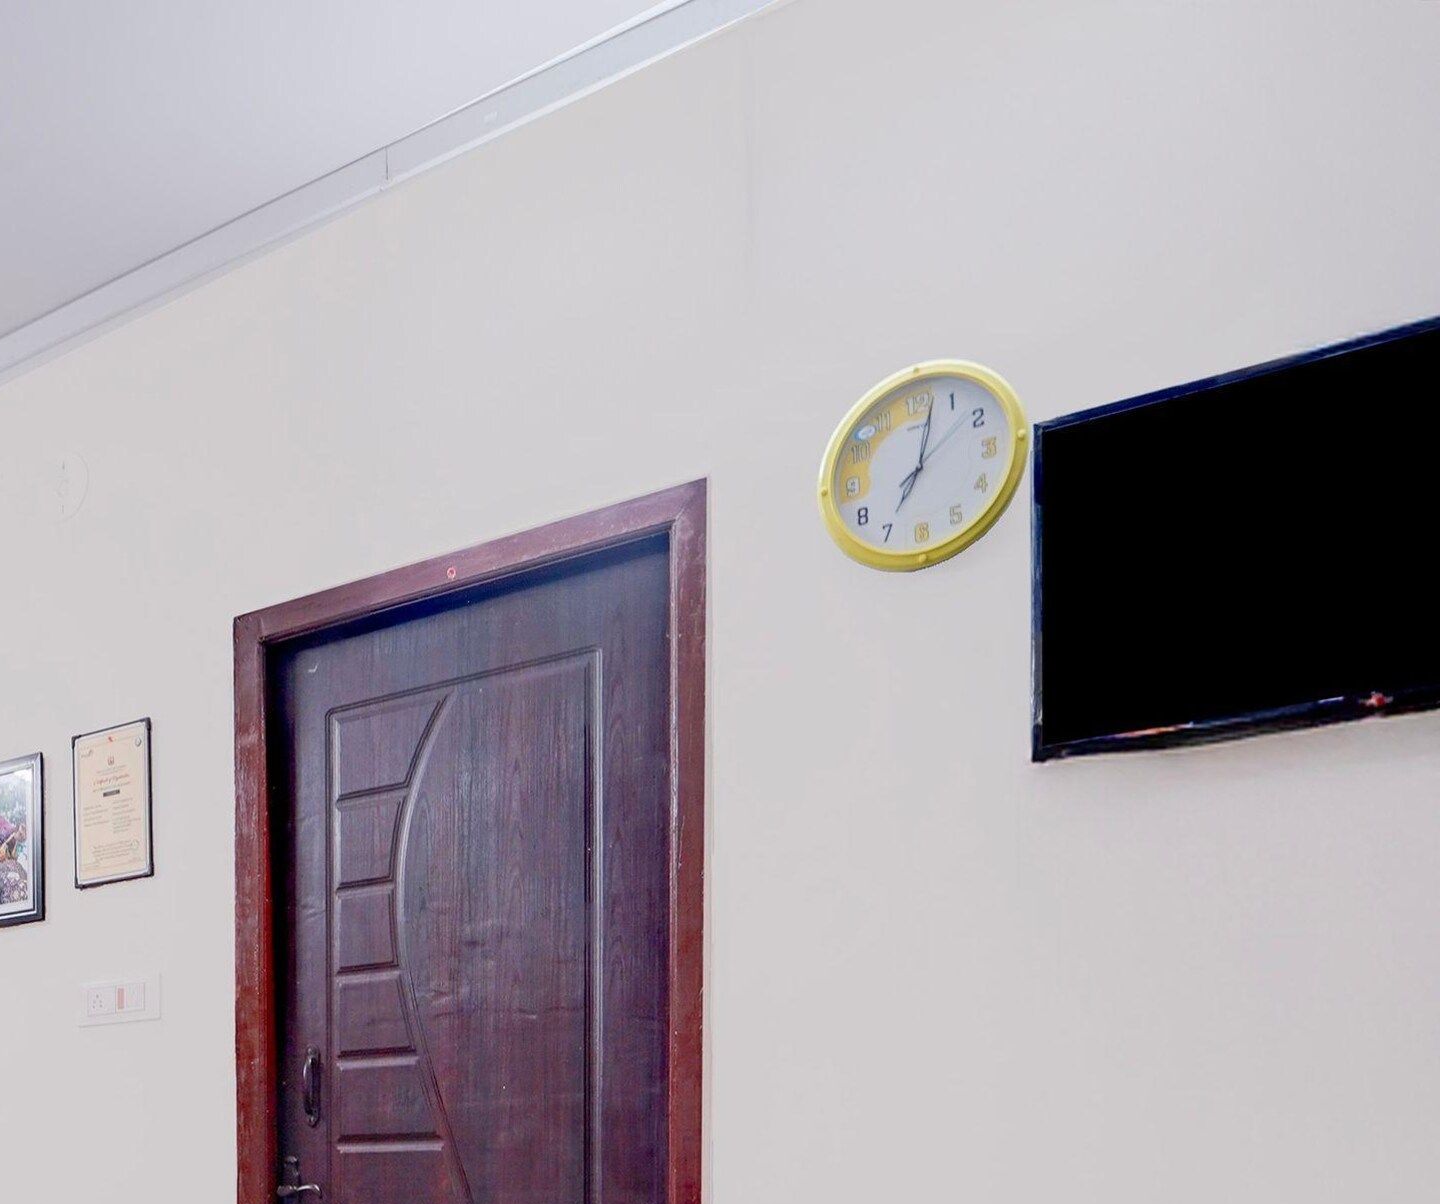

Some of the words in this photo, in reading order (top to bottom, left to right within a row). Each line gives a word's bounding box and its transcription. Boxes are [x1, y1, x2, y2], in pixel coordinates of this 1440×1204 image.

[949, 392, 955, 410] 1
[972, 408, 985, 428] 2
[850, 443, 870, 464] 10
[981, 437, 997, 459] 3
[846, 476, 860, 496] 9
[974, 473, 988, 493] 4
[857, 507, 869, 526] 8
[949, 504, 963, 525] 5
[882, 523, 893, 543] 7
[914, 521, 930, 543] 6
